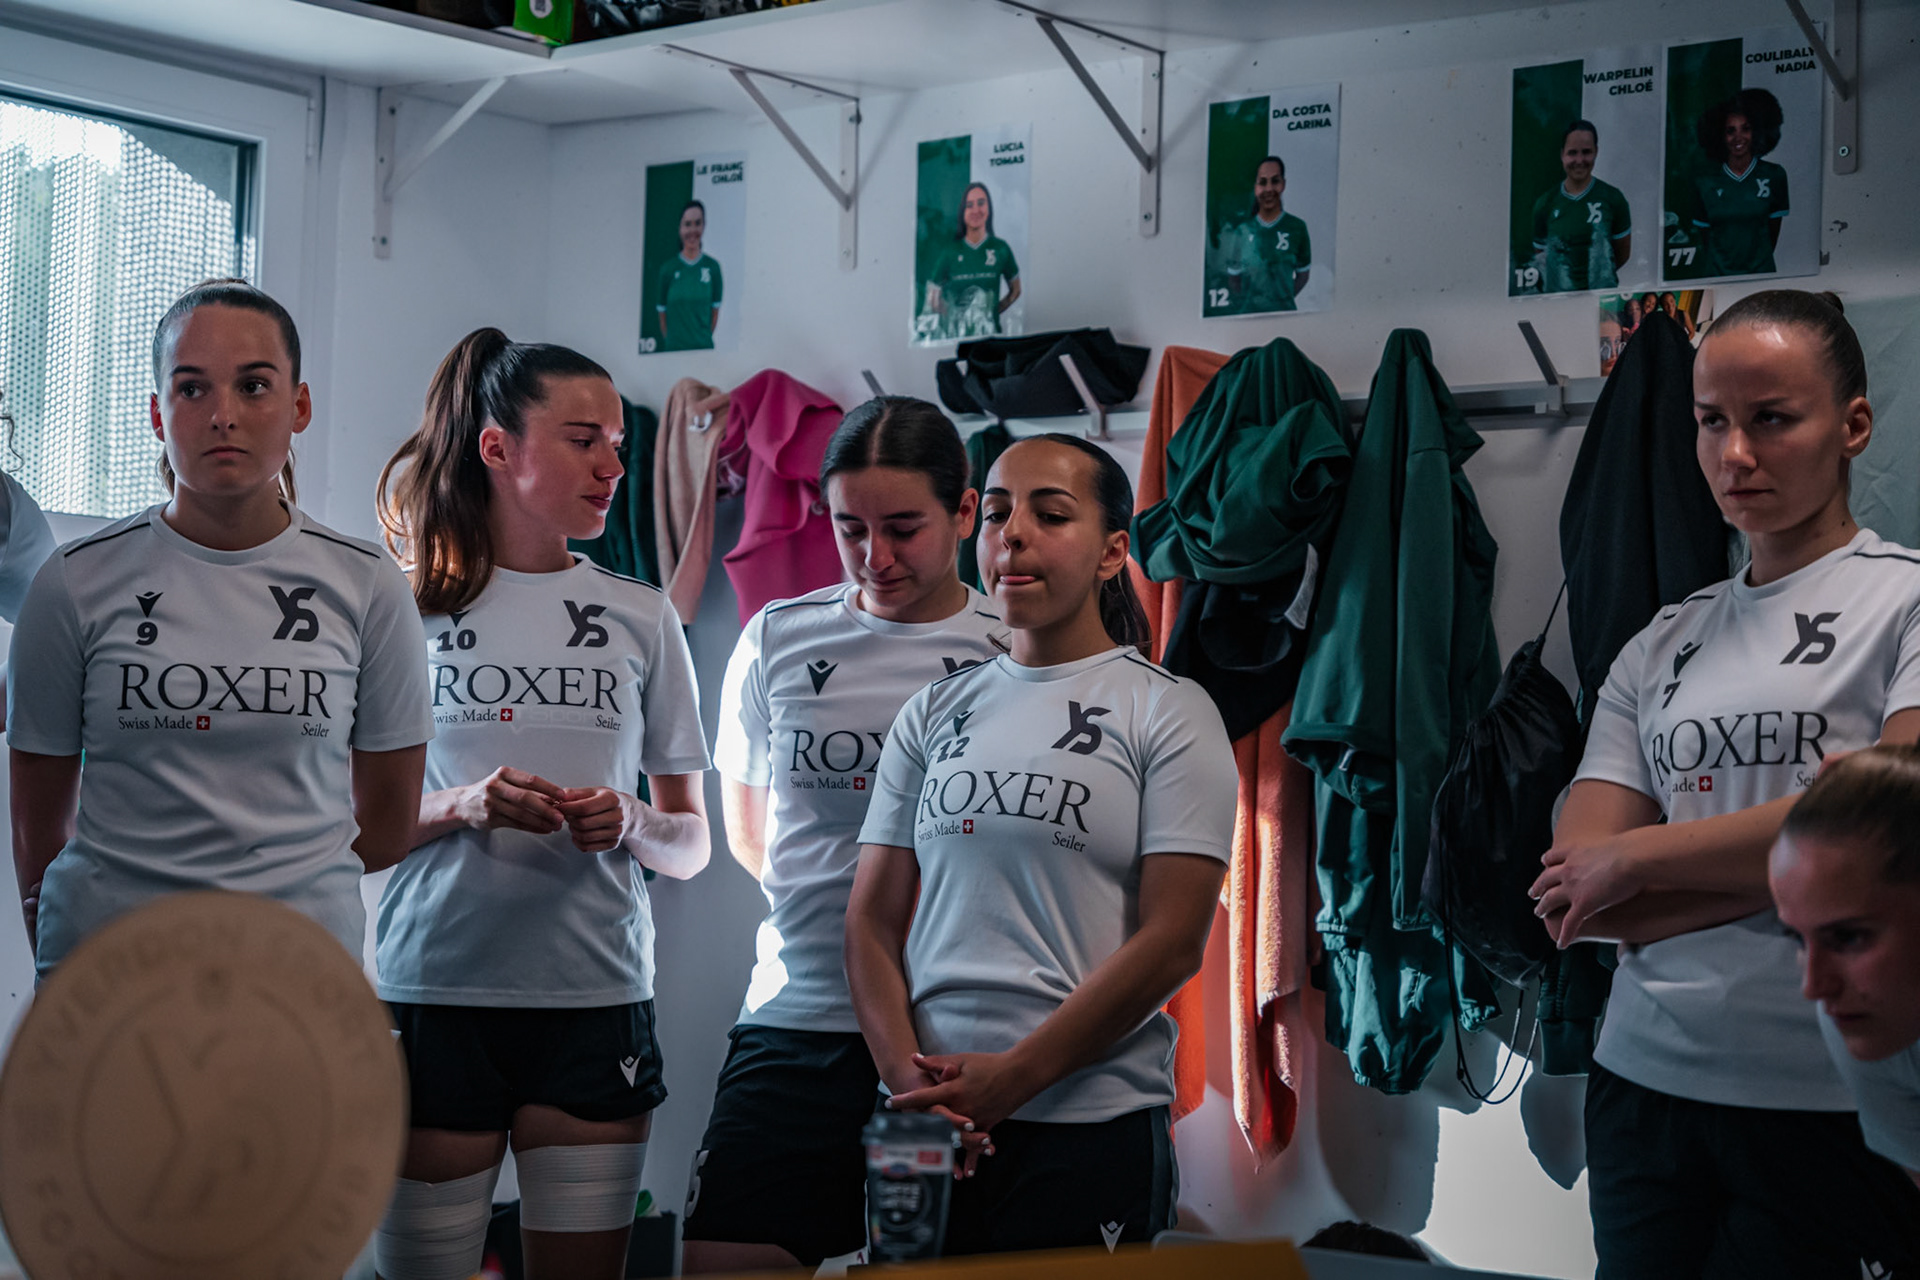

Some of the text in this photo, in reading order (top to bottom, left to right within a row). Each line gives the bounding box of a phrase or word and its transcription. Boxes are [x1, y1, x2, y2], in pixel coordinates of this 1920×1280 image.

[1583, 66, 1654, 84] WARPELIN
[1775, 60, 1816, 75] NADIA
[1609, 79, 1653, 96] CHLOÉ
[1272, 103, 1332, 119] DA COSTA
[1287, 118, 1332, 131] CARINA
[990, 155, 1025, 167] TOMAS
[1668, 247, 1697, 267] 77
[1515, 267, 1539, 288] 19
[1209, 287, 1229, 307] 12
[135, 621, 159, 646] 9
[436, 629, 477, 652] 10
[117, 663, 332, 719] ROXER
[432, 664, 622, 714] ROXER
[1662, 681, 1681, 710] 7
[118, 715, 193, 730] Swiss Made
[462, 708, 497, 723] Made
[595, 715, 621, 731] Seiler
[301, 722, 330, 738] Seiler
[936, 736, 970, 764] 12
[1652, 711, 1828, 787] ROXER
[791, 776, 850, 790] Swiss Made
[918, 770, 1091, 834] ROXER
[934, 821, 960, 837] Made
[1052, 831, 1086, 852] Seiler
